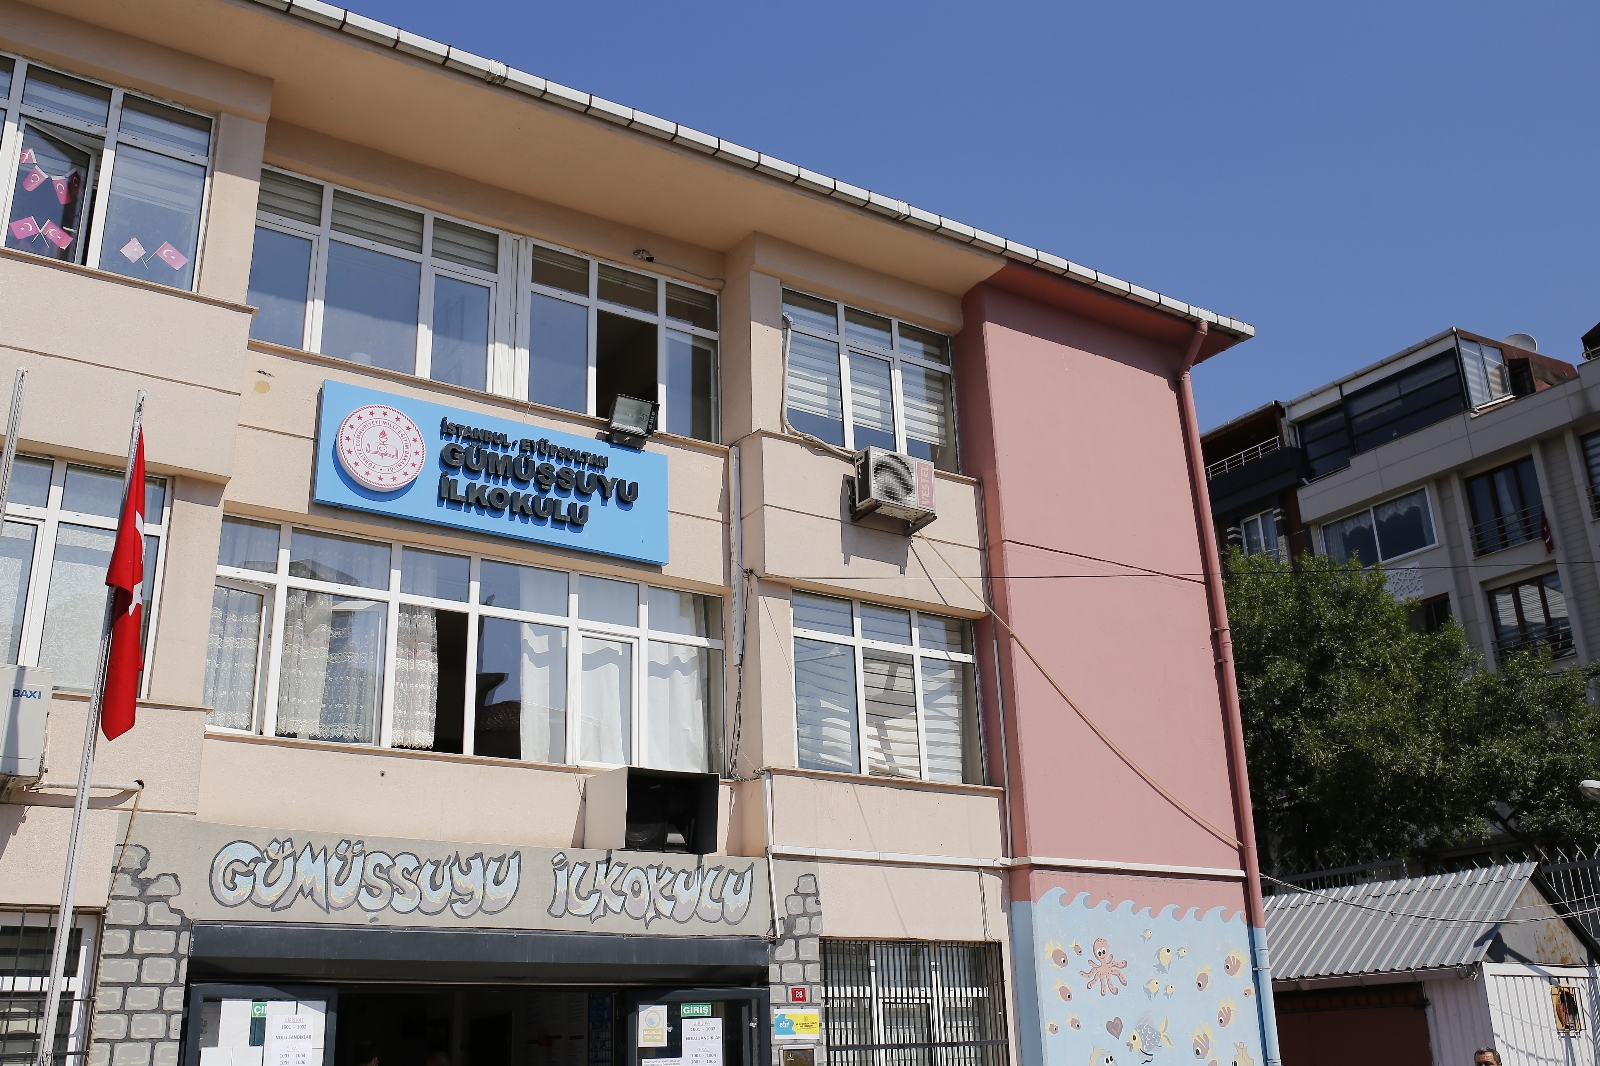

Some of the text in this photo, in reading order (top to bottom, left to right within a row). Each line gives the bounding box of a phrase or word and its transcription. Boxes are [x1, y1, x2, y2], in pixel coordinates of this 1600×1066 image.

[440, 442, 639, 503] GÜMÜŞSUYU
[520, 437, 609, 468] EYÜPSULTAN
[440, 470, 590, 525] İLKOKULU
[920, 465, 931, 505] VESTEL
[12, 688, 42, 700] BAXI
[547, 852, 755, 930] İLKOKULU
[682, 1004, 709, 1016] GİRİŞ
